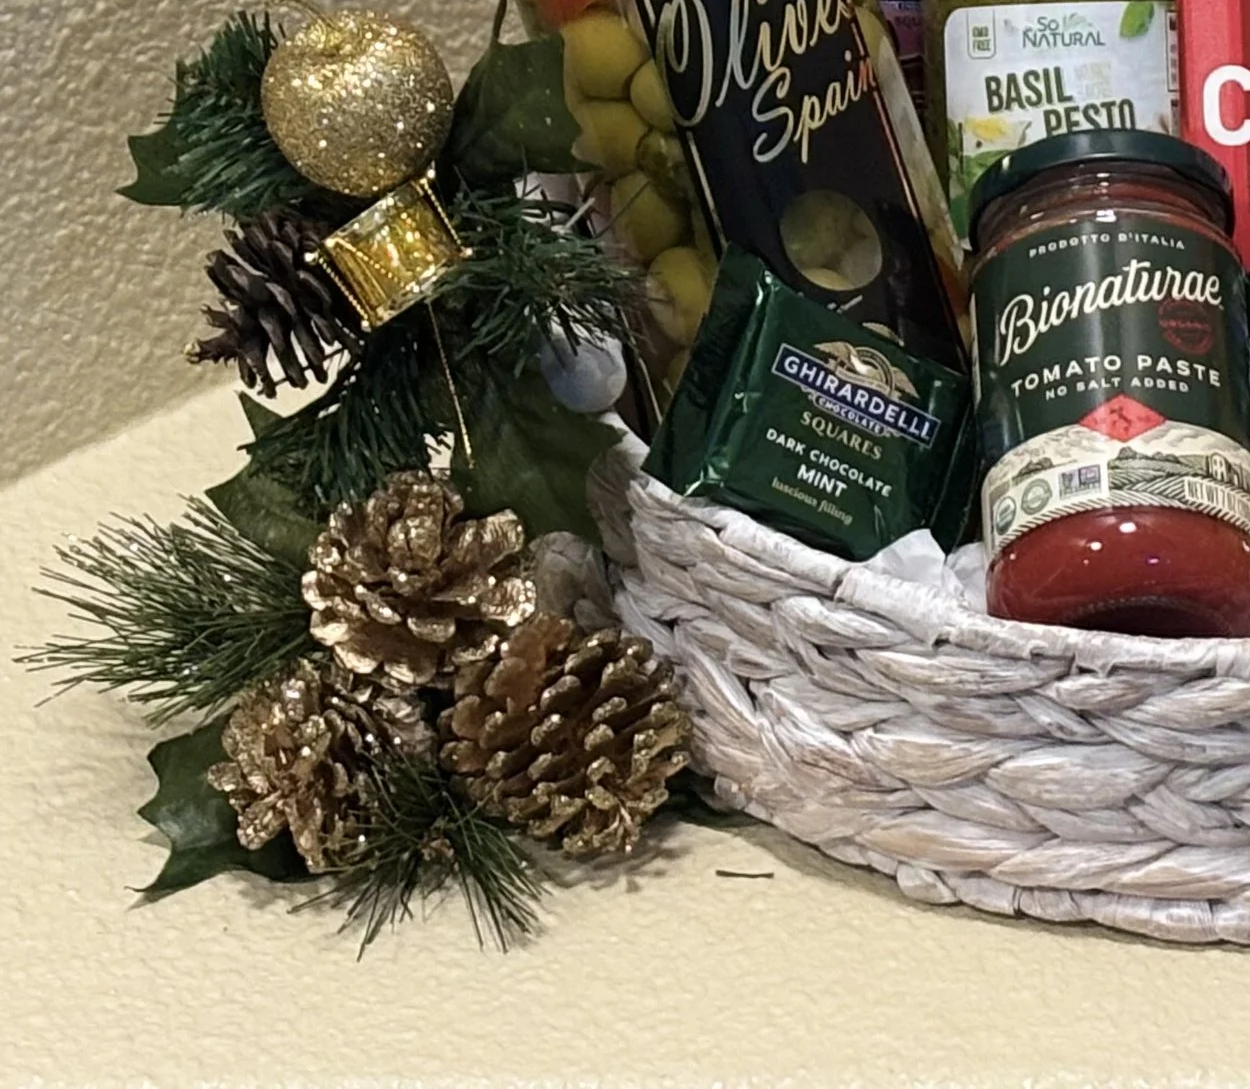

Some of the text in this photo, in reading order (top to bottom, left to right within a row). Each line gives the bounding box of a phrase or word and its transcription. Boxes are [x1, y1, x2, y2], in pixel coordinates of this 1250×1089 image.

[972, 37, 991, 53] FREE
[1022, 29, 1107, 49] NATURAL
[984, 65, 1073, 113] BASIL
[1028, 231, 1186, 259] PRODOTTO D'ITALIA
[998, 259, 1223, 367] Bionaturae
[782, 354, 932, 442] GHIRARDELLI
[1010, 354, 1222, 398] TOMATO PASTE
[1045, 376, 1190, 402] NO SALT ADDED
[799, 410, 884, 461] SQUARES
[818, 396, 883, 435] CHOCOLATE
[766, 427, 893, 498] DARK CHOCOLATE
[796, 463, 848, 499] MINT
[771, 475, 854, 527] luscious filling
